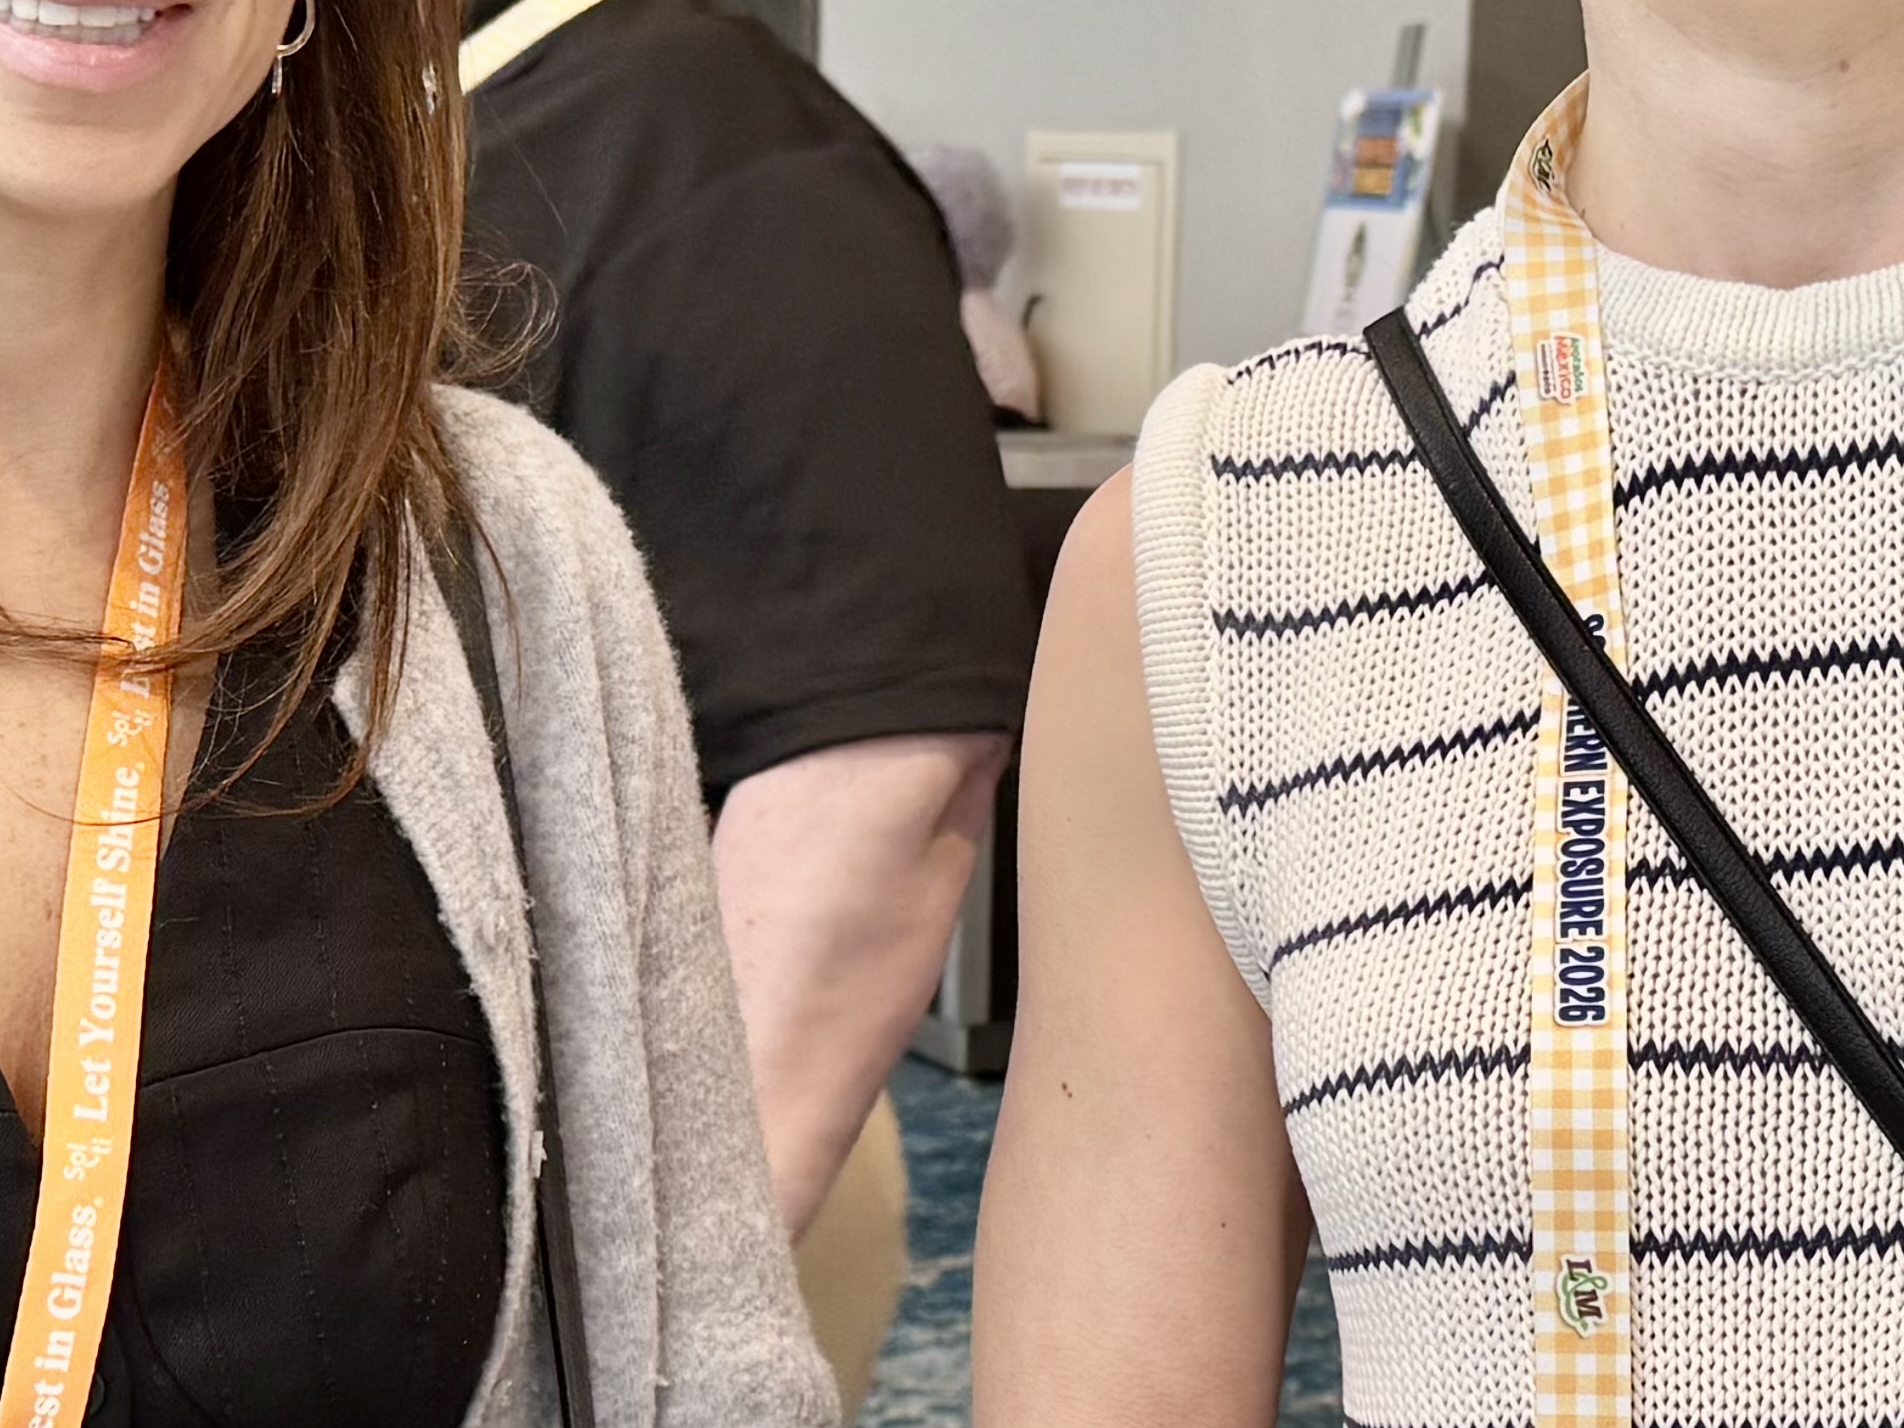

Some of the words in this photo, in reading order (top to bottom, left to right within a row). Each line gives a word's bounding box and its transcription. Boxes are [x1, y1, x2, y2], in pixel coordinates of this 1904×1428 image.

[129, 582, 162, 622] in
[120, 618, 158, 700] Bst
[1559, 779, 1606, 941] EXPOSURE
[78, 876, 128, 1047] Yourself
[1559, 946, 1606, 1024] 2026
[72, 1054, 111, 1122] Let
[46, 1195, 104, 1322] Glass.
[34, 1329, 75, 1375] in
